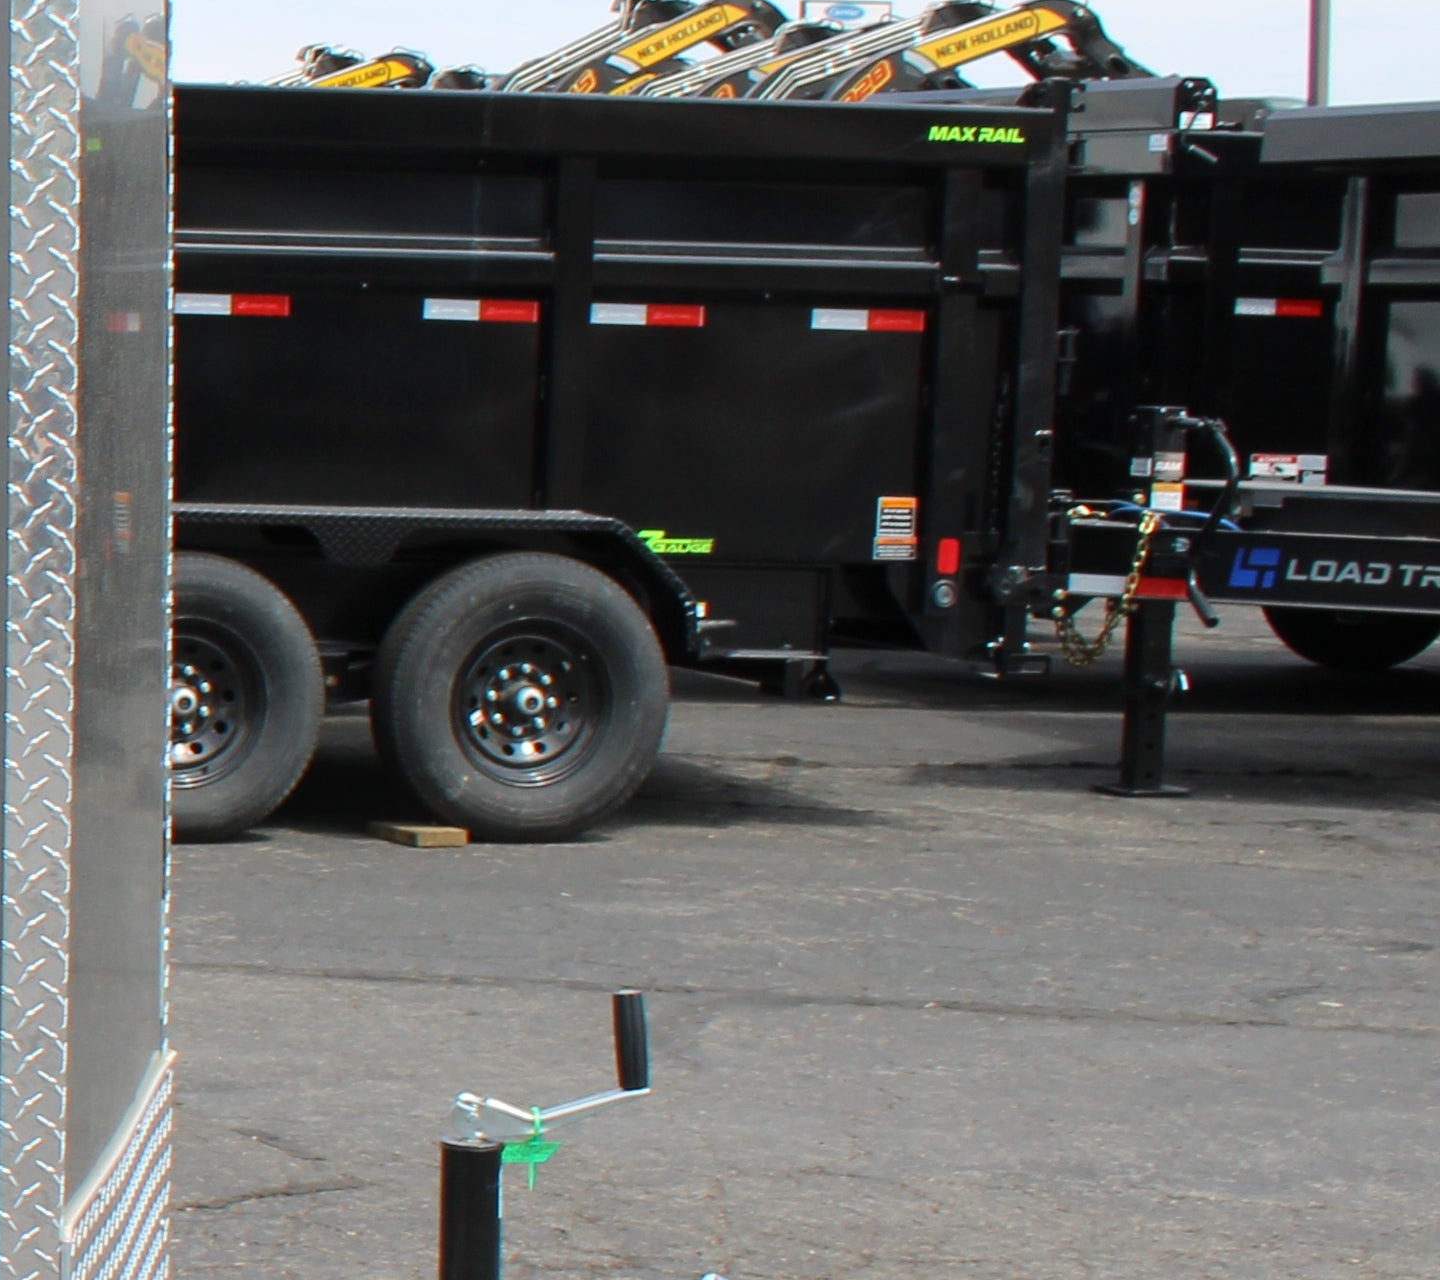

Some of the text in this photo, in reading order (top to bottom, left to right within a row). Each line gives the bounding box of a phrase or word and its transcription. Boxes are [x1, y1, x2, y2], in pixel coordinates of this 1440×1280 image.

[637, 12, 722, 59] NEW HOLLAND
[935, 17, 1035, 59] NEW HOLLAND
[928, 125, 1026, 143] MAX RAIL
[1285, 558, 1392, 585] LOAD
